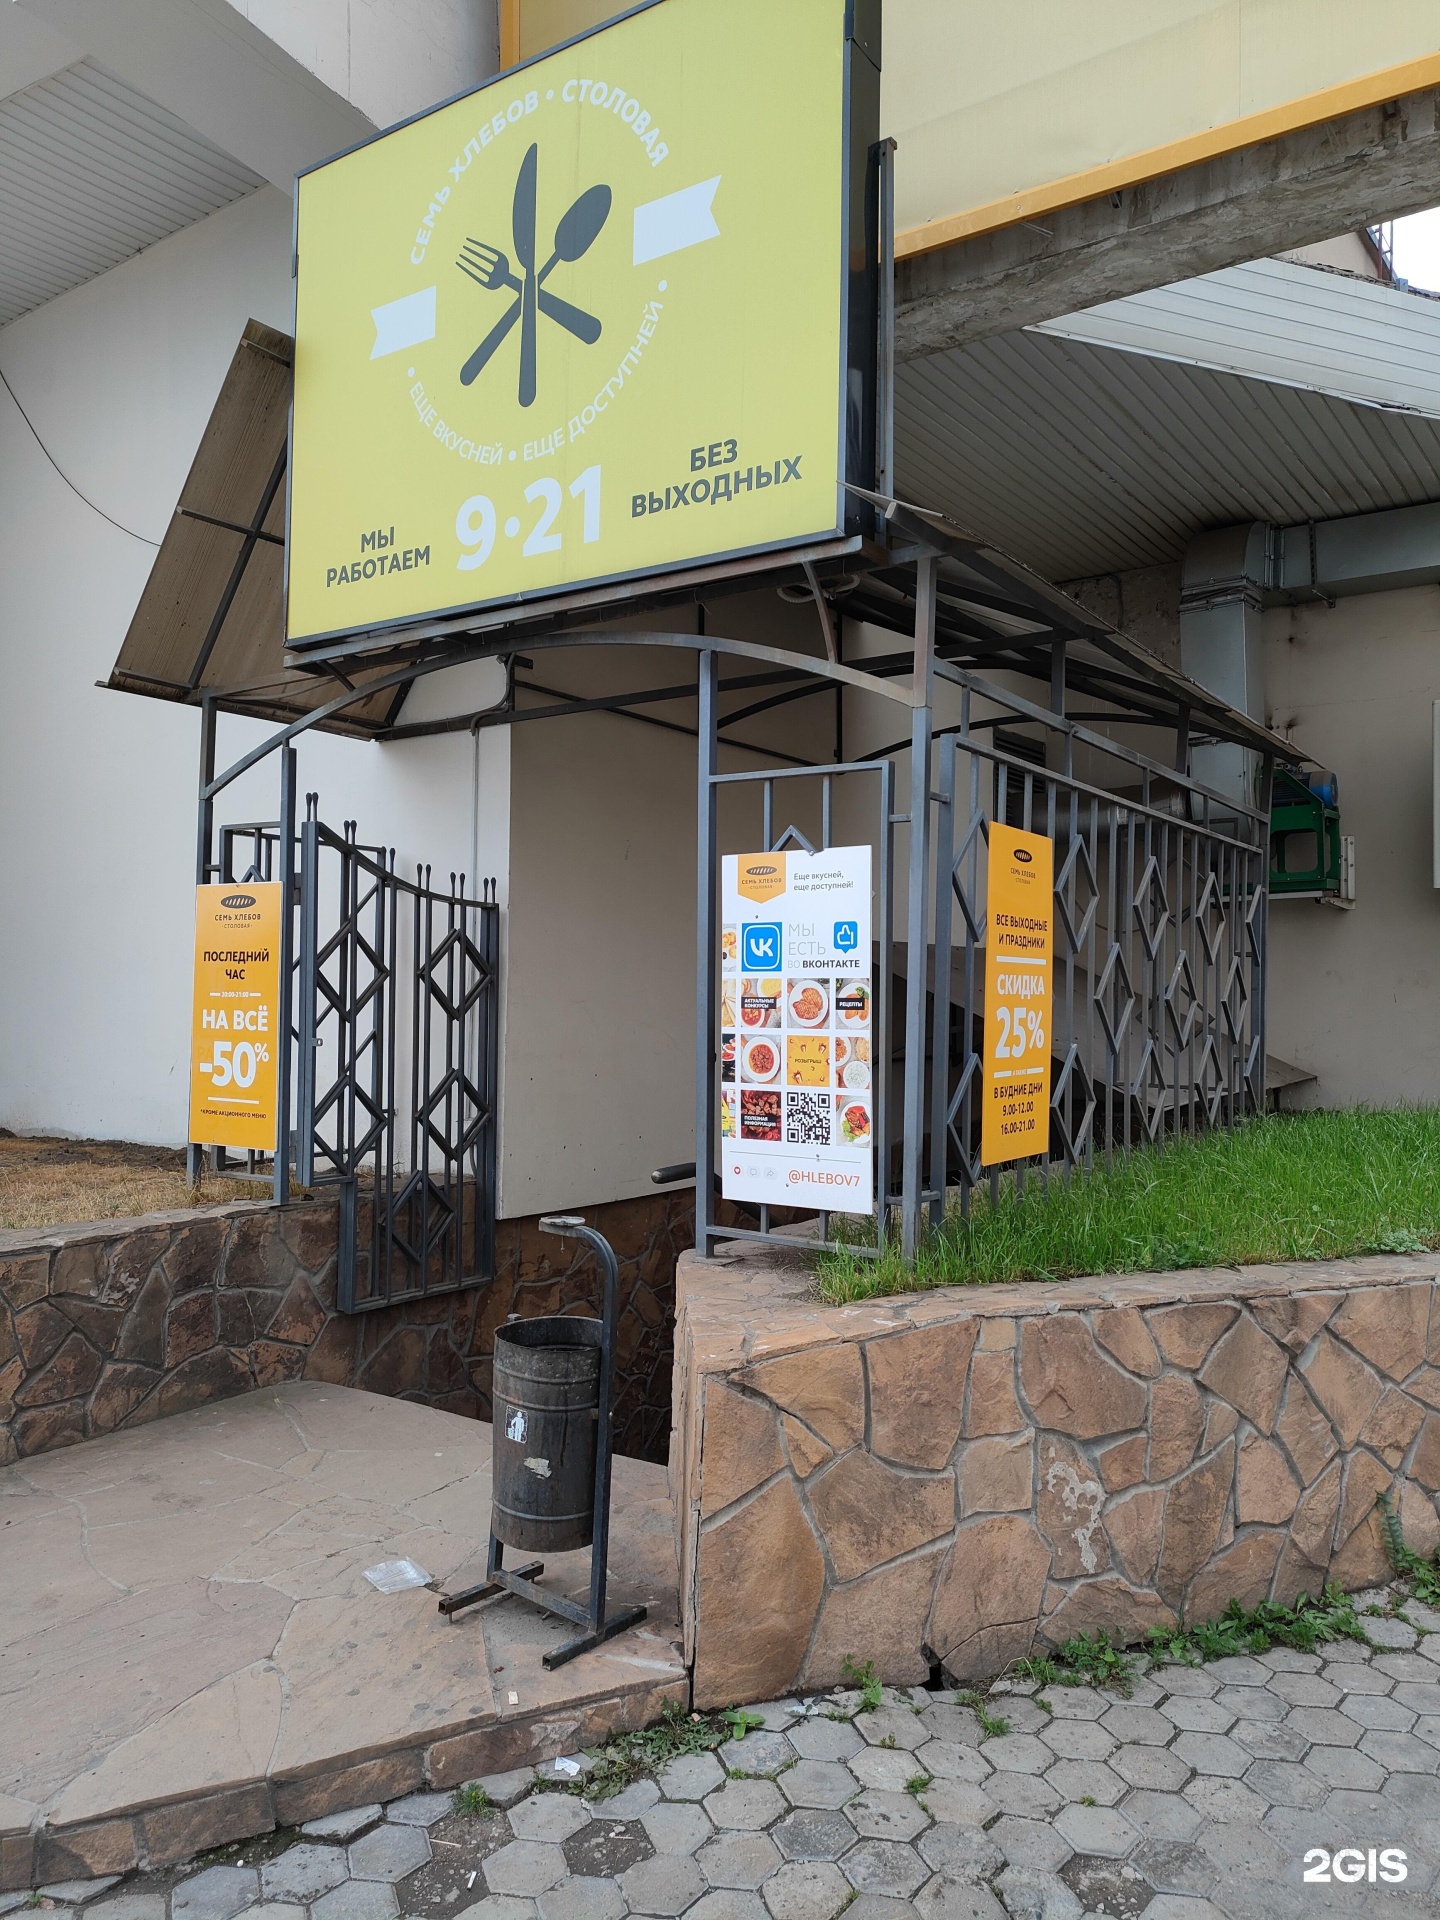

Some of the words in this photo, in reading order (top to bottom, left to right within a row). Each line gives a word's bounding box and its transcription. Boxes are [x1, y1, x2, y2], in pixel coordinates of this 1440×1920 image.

[410, 186, 451, 265] СЕМЬ
[448, 90, 539, 183] ХЛЕБОВ
[562, 79, 669, 167] СТОЛОВАЯ
[409, 381, 438, 427] ЕЩЕ
[432, 419, 504, 465] ВКУСНЕЙ
[523, 427, 566, 462] ЕЩЕ
[567, 300, 664, 443] ДОСТУПНЕЙ
[690, 439, 738, 473] БЕЗ
[631, 455, 803, 518] ВЫХОДНЫХ
[361, 526, 395, 553] МЫ
[326, 545, 431, 588] РАБОТАЕМ
[794, 873, 810, 881] Еще
[812, 871, 845, 881] вкусней,
[794, 883, 810, 891] еще
[811, 881, 854, 891] доступней!
[788, 923, 815, 937] МЫ
[996, 914, 1009, 926] ВСЕ
[1010, 916, 1048, 932] ВЫХОДНЫЕ
[788, 942, 826, 956] ЕСТЬ
[998, 933, 1004, 945] И
[1005, 934, 1045, 949] ПРАЗДНИКИ
[203, 948, 270, 964] ПОСЛЕДНИЙ
[787, 960, 801, 969] ВО
[802, 960, 860, 969] ВКОНТАКТЕ
[225, 969, 246, 980] ЧАС
[996, 973, 1045, 1000] СКИДКА
[202, 1009, 229, 1030] НА
[233, 1004, 269, 1032] ВСЁ
[994, 1007, 1045, 1059] 25%
[199, 1041, 270, 1088] -50%
[994, 1087, 999, 1099] В
[1000, 1084, 1027, 1100] БУДНИЕ
[1028, 1082, 1043, 1097] ДНИ
[218, 1110, 251, 1118] АКЦИОННОГО
[1002, 1101, 1034, 1116] 9.00-12.00
[1000, 1119, 1035, 1136] 16.00-21.00
[788, 1169, 861, 1187] @HLEBOV7
